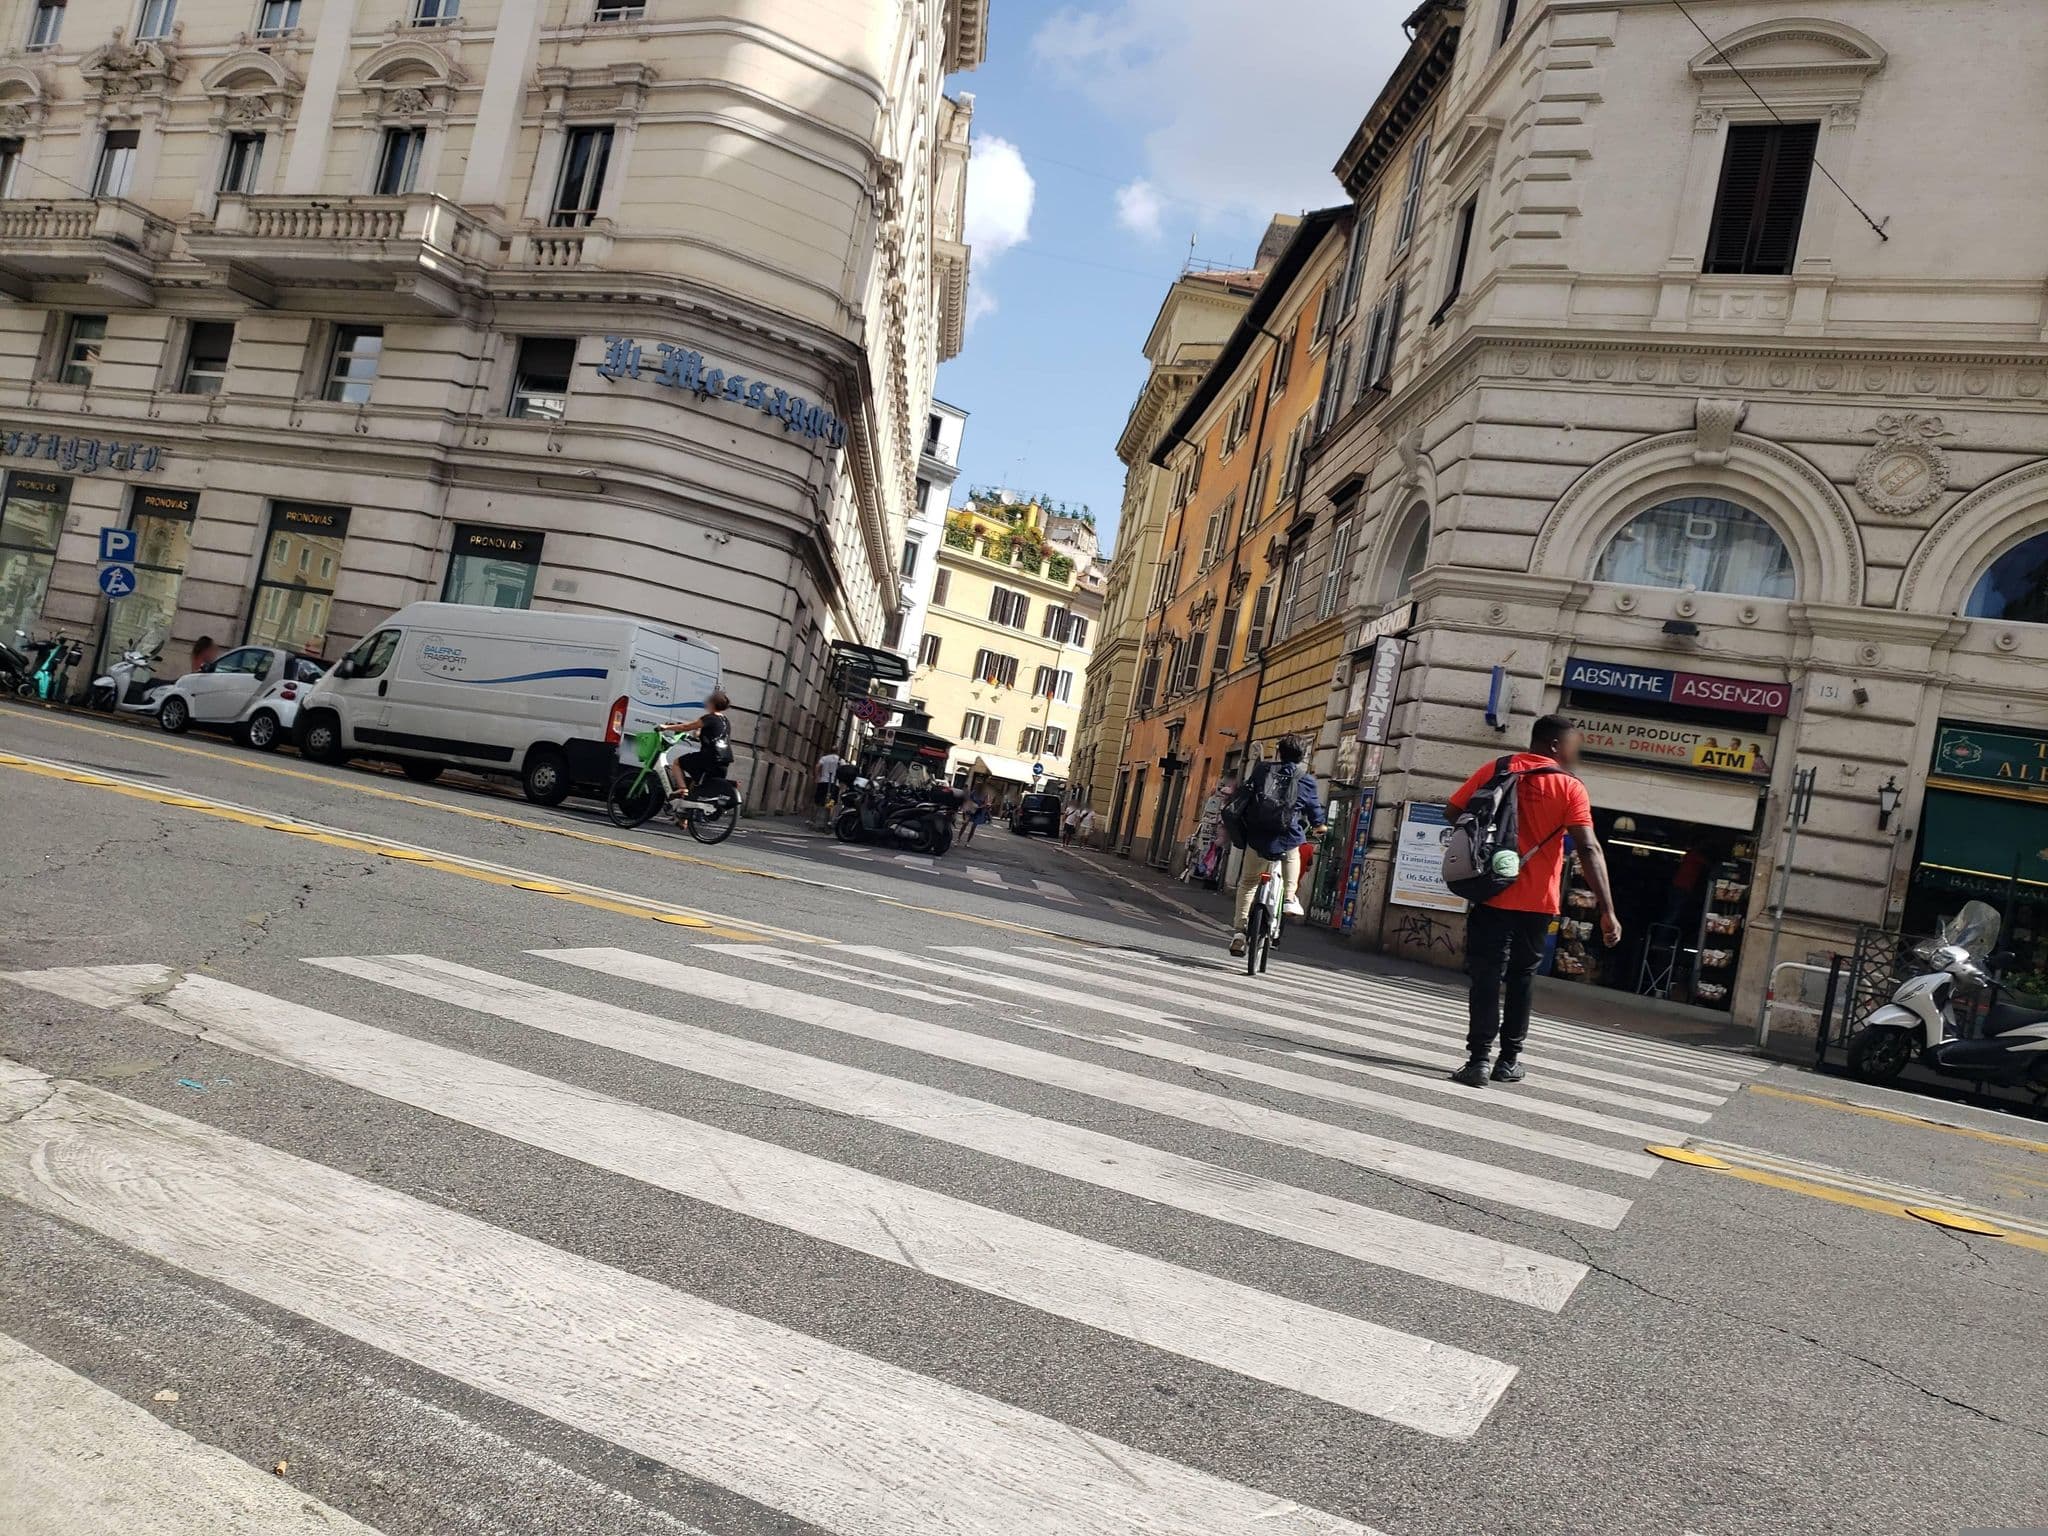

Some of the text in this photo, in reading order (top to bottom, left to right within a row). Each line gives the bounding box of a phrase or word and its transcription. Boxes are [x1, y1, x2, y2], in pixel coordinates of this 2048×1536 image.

[16, 478, 57, 493] PRONOVIAS
[145, 495, 190, 511] PRONOVIAS
[285, 511, 334, 526] PRONOVIAS
[105, 531, 130, 557] P
[470, 534, 524, 550] PRONOVIAS
[1571, 666, 1664, 693] ABSINTHE
[1364, 639, 1401, 742] ABSENTE
[1681, 679, 1783, 708] ASSENZIO
[1820, 686, 1839, 698] 131
[1568, 717, 1701, 745] TALIAN PRODUCT
[1629, 739, 1687, 757] DRINKS
[1701, 750, 1746, 769] ATM
